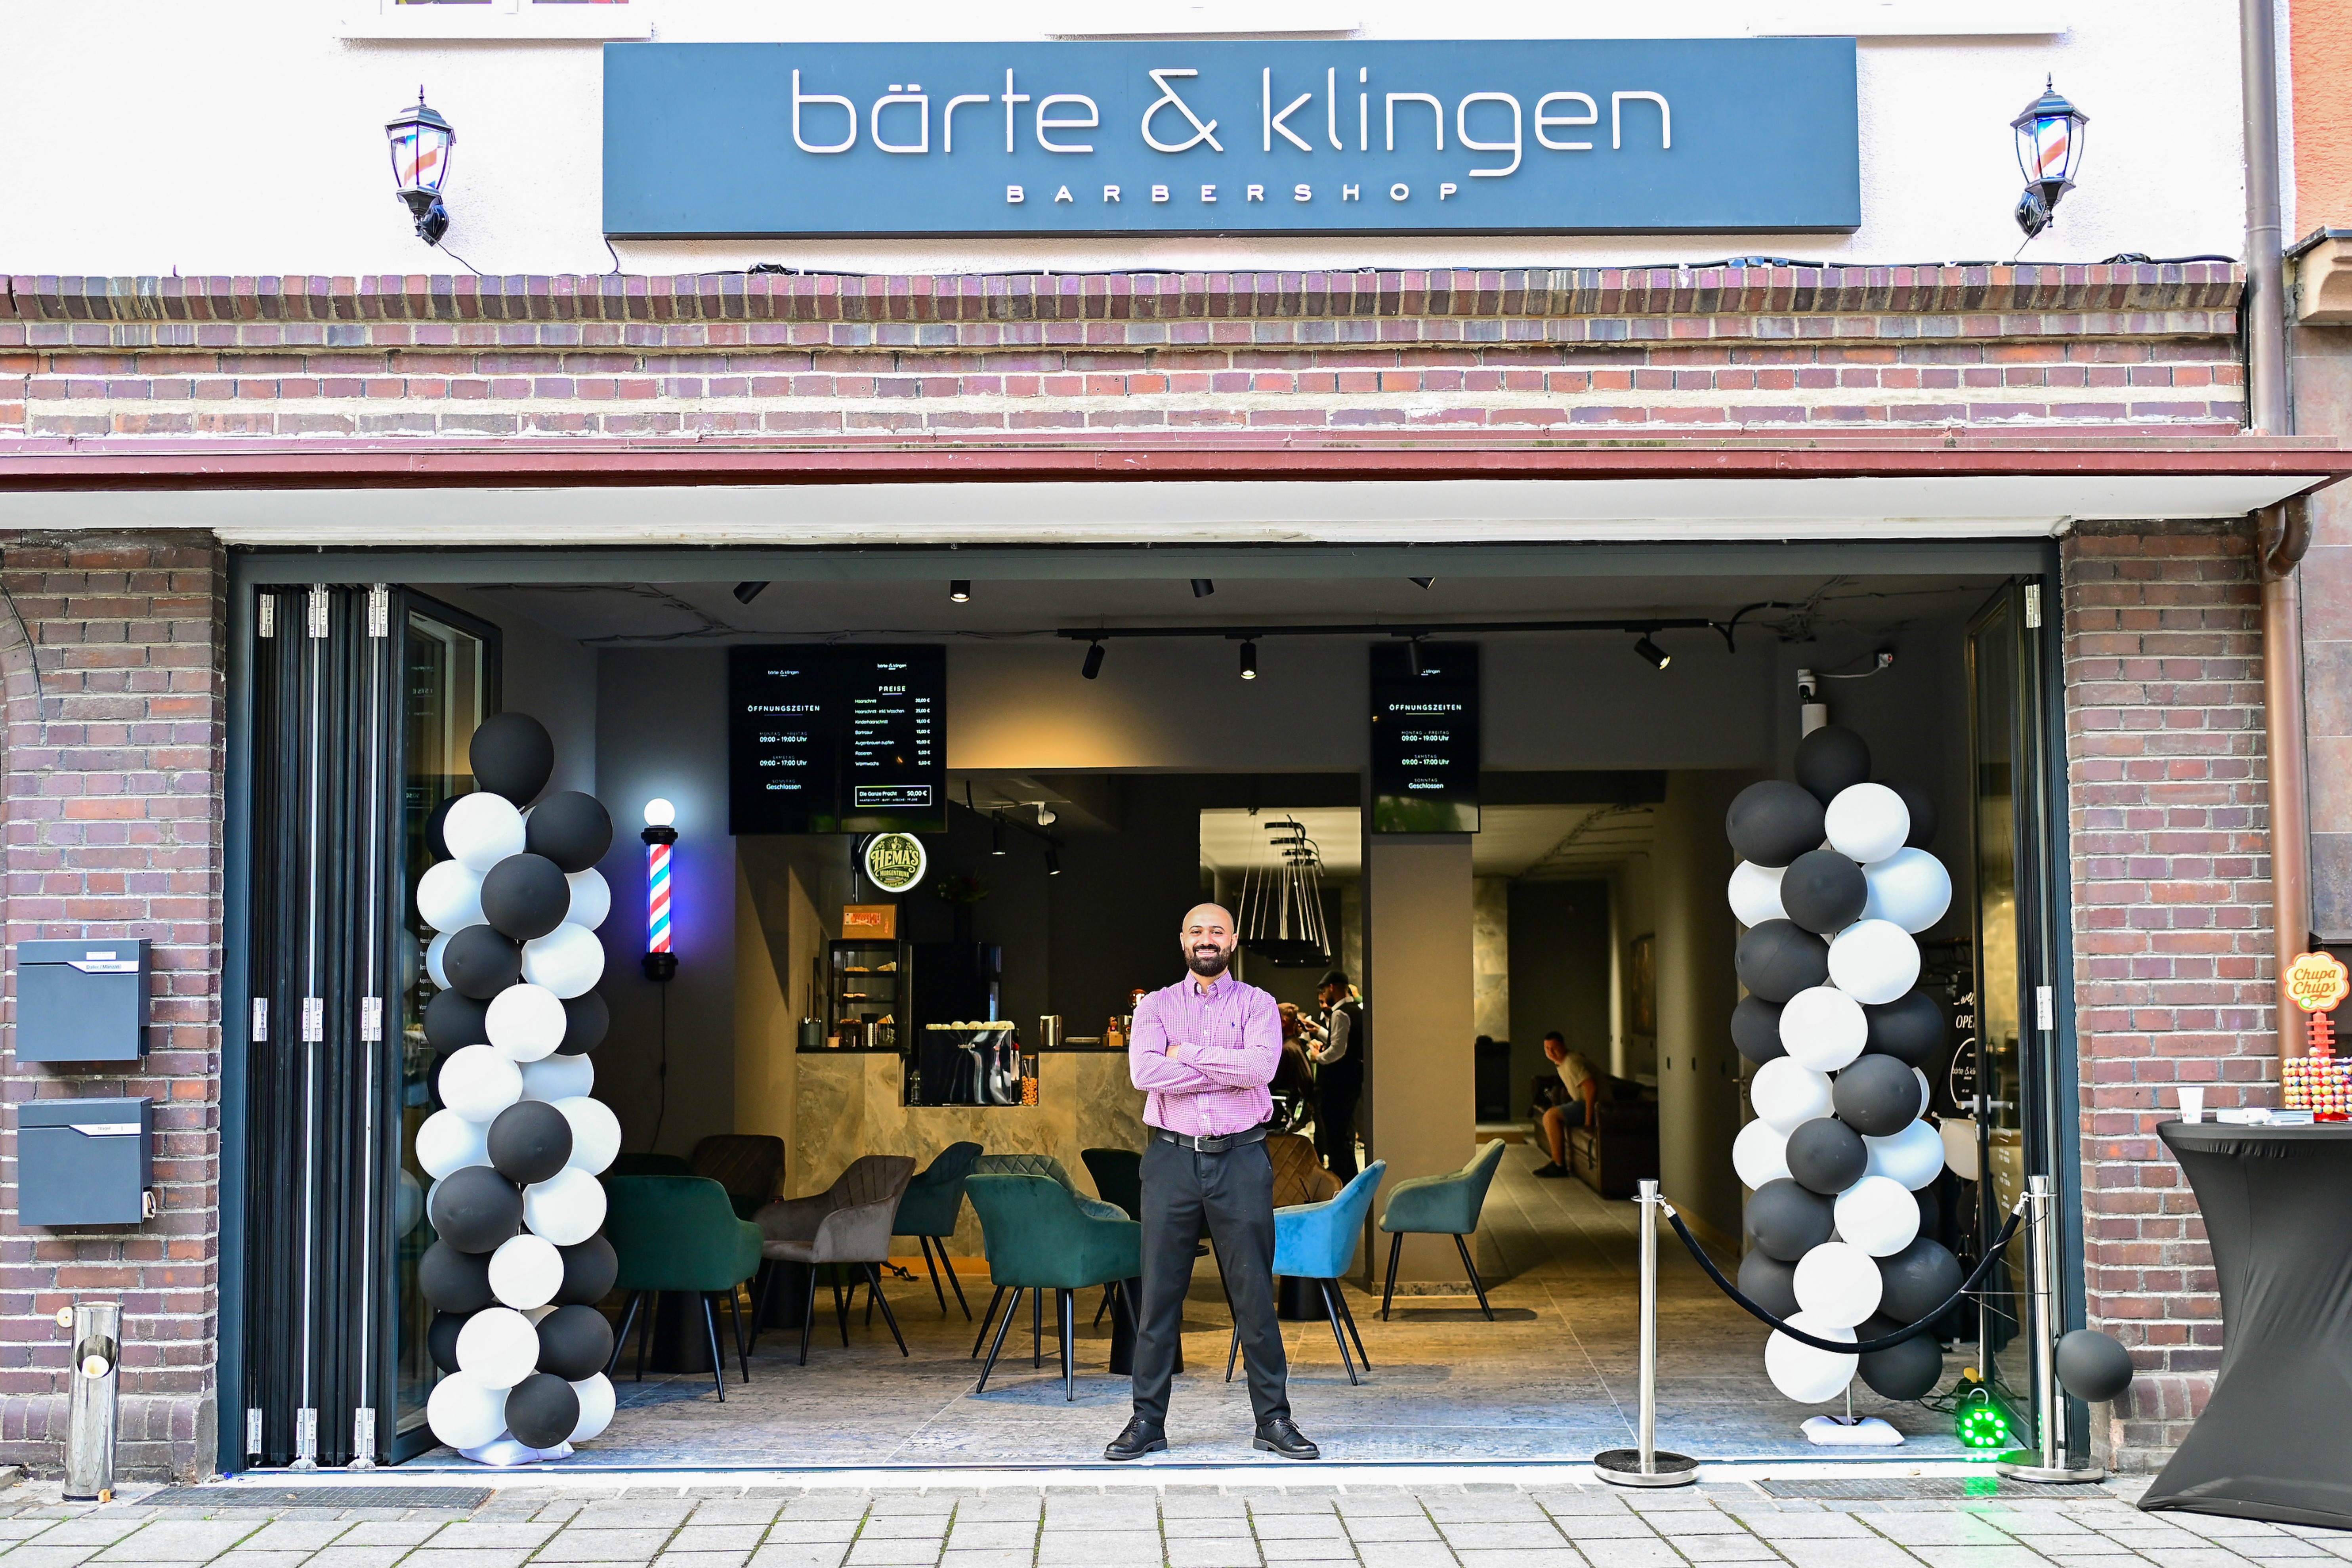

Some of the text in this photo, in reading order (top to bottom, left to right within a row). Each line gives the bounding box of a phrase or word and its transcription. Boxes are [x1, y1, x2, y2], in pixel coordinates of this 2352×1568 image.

[792, 67, 1671, 177] bärte & klingen
[1006, 183, 1457, 203] BARBERSHOP
[2294, 968, 2336, 982] Chupa
[2293, 981, 2336, 1001] Chups
